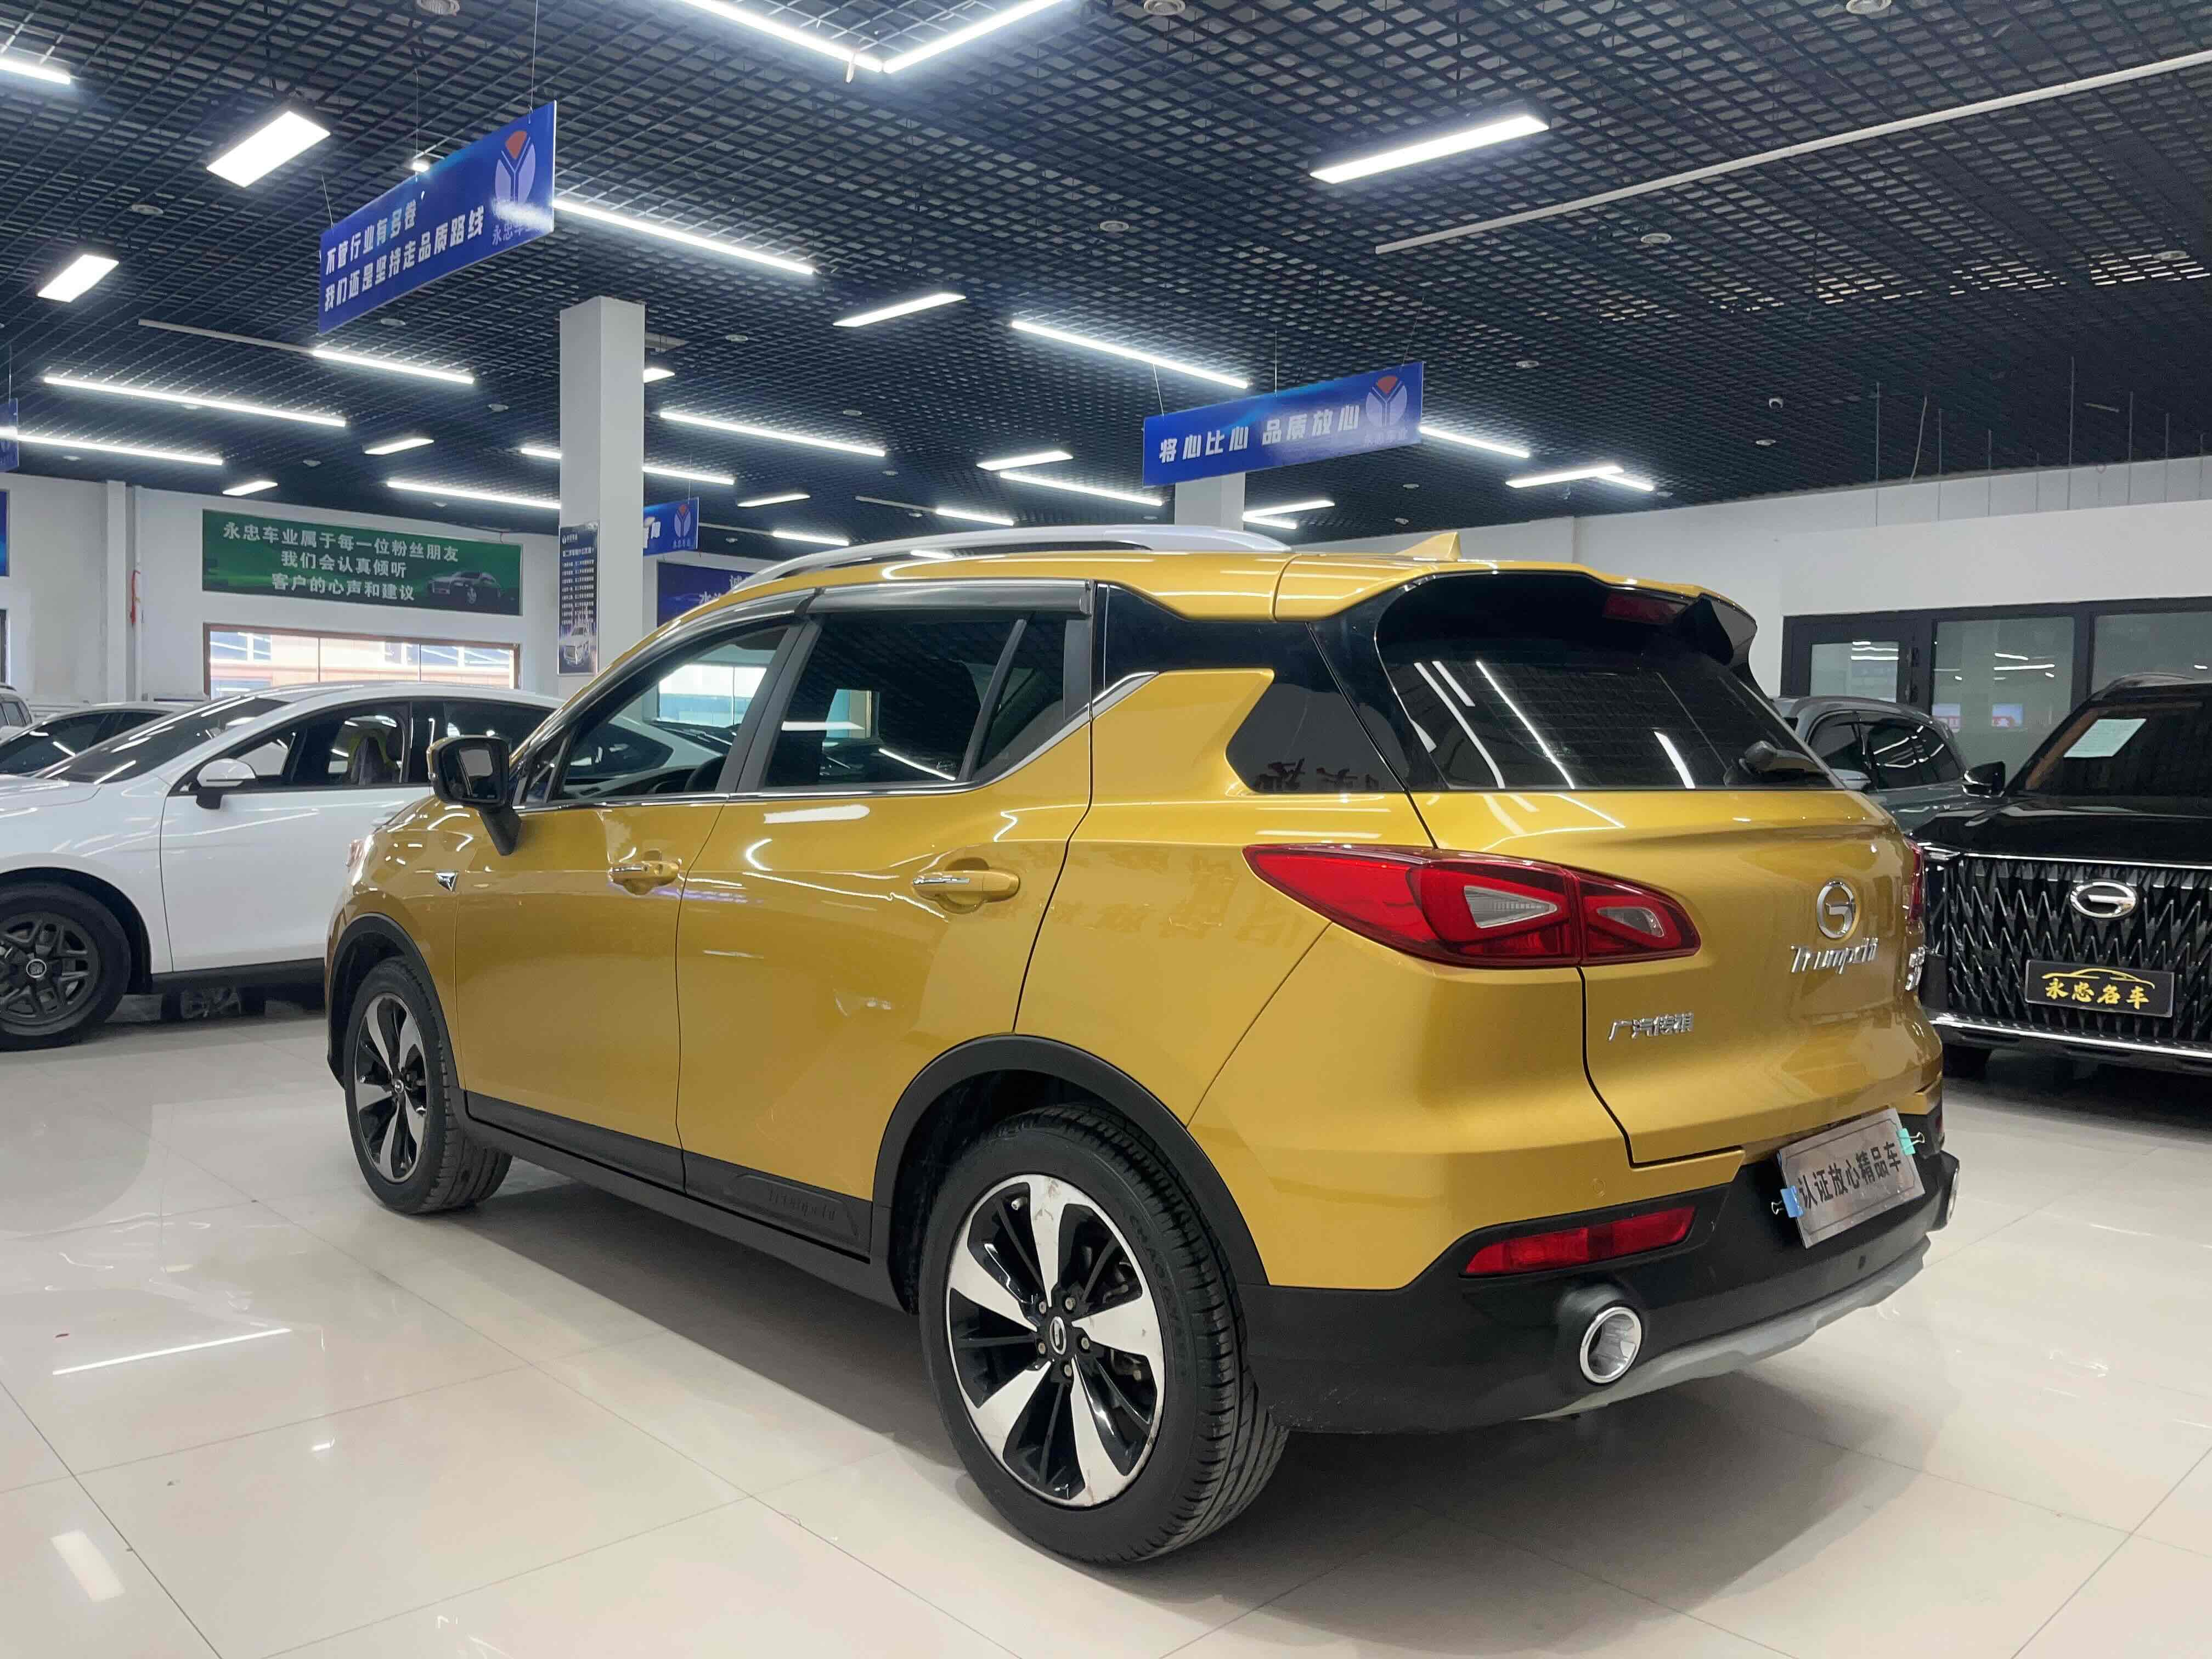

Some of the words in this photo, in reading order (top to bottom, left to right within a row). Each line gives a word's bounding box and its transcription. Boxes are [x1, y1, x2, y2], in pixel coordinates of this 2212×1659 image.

[325, 205, 484, 312] 我们还是坚持走品质路线
[1159, 426, 1249, 463] 将心比心
[1262, 405, 1360, 445] 品质放心
[223, 522, 459, 562] 永忠车业属于每一位粉丝朋友
[281, 550, 407, 578] 我们会认真倾听
[272, 573, 415, 601] 客户的心声和建议
[2045, 978, 2149, 1009] 永忠名车
[1798, 1141, 1901, 1209] 认证放心精品车
